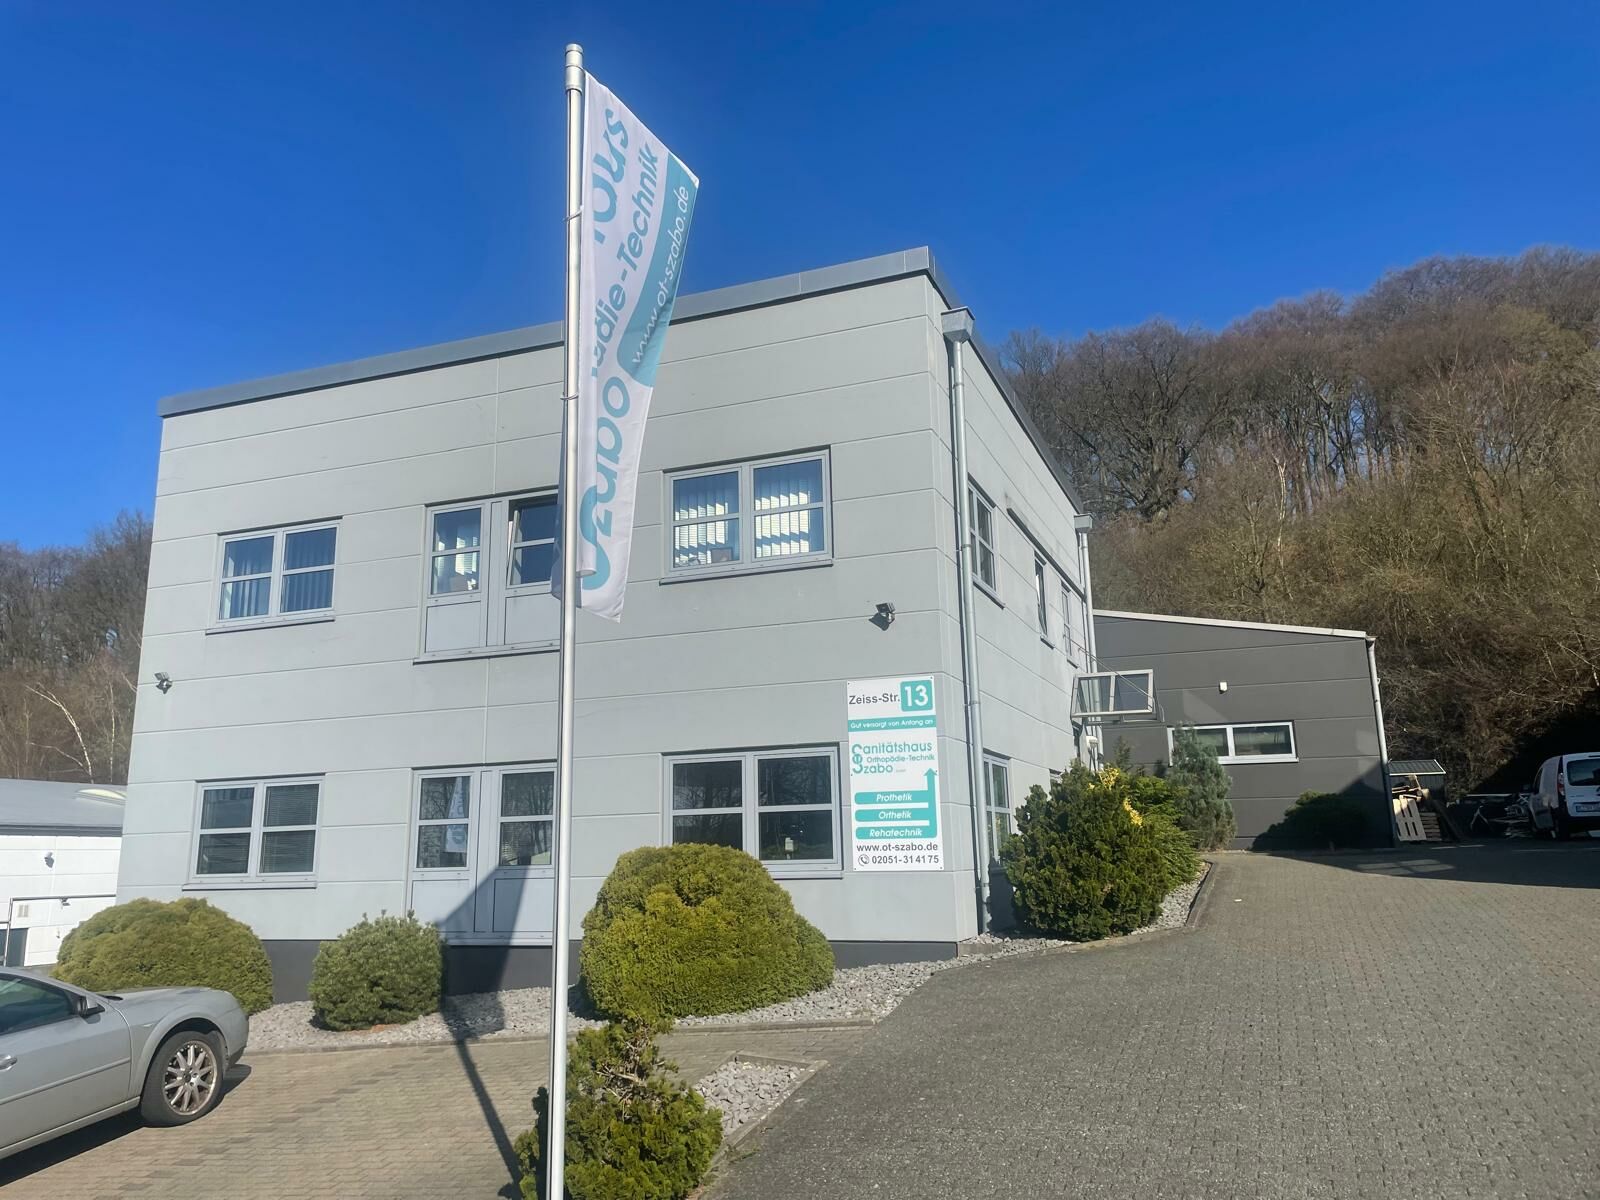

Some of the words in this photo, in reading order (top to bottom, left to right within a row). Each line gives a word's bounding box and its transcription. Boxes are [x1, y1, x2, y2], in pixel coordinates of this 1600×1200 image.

[849, 692, 900, 705] Zeiss-Str.
[904, 685, 929, 707] 13
[862, 720, 887, 729] versorgt
[901, 719, 923, 727] Anfang
[851, 741, 933, 754] Sanitätshaus
[866, 753, 935, 764] Orthopädie-Technik
[852, 763, 893, 774] Szabo
[876, 793, 912, 802] Prothetik
[878, 810, 912, 820] Orthetik
[869, 828, 923, 837] Rehatechnik
[856, 842, 938, 852] www.ot-szabo.de
